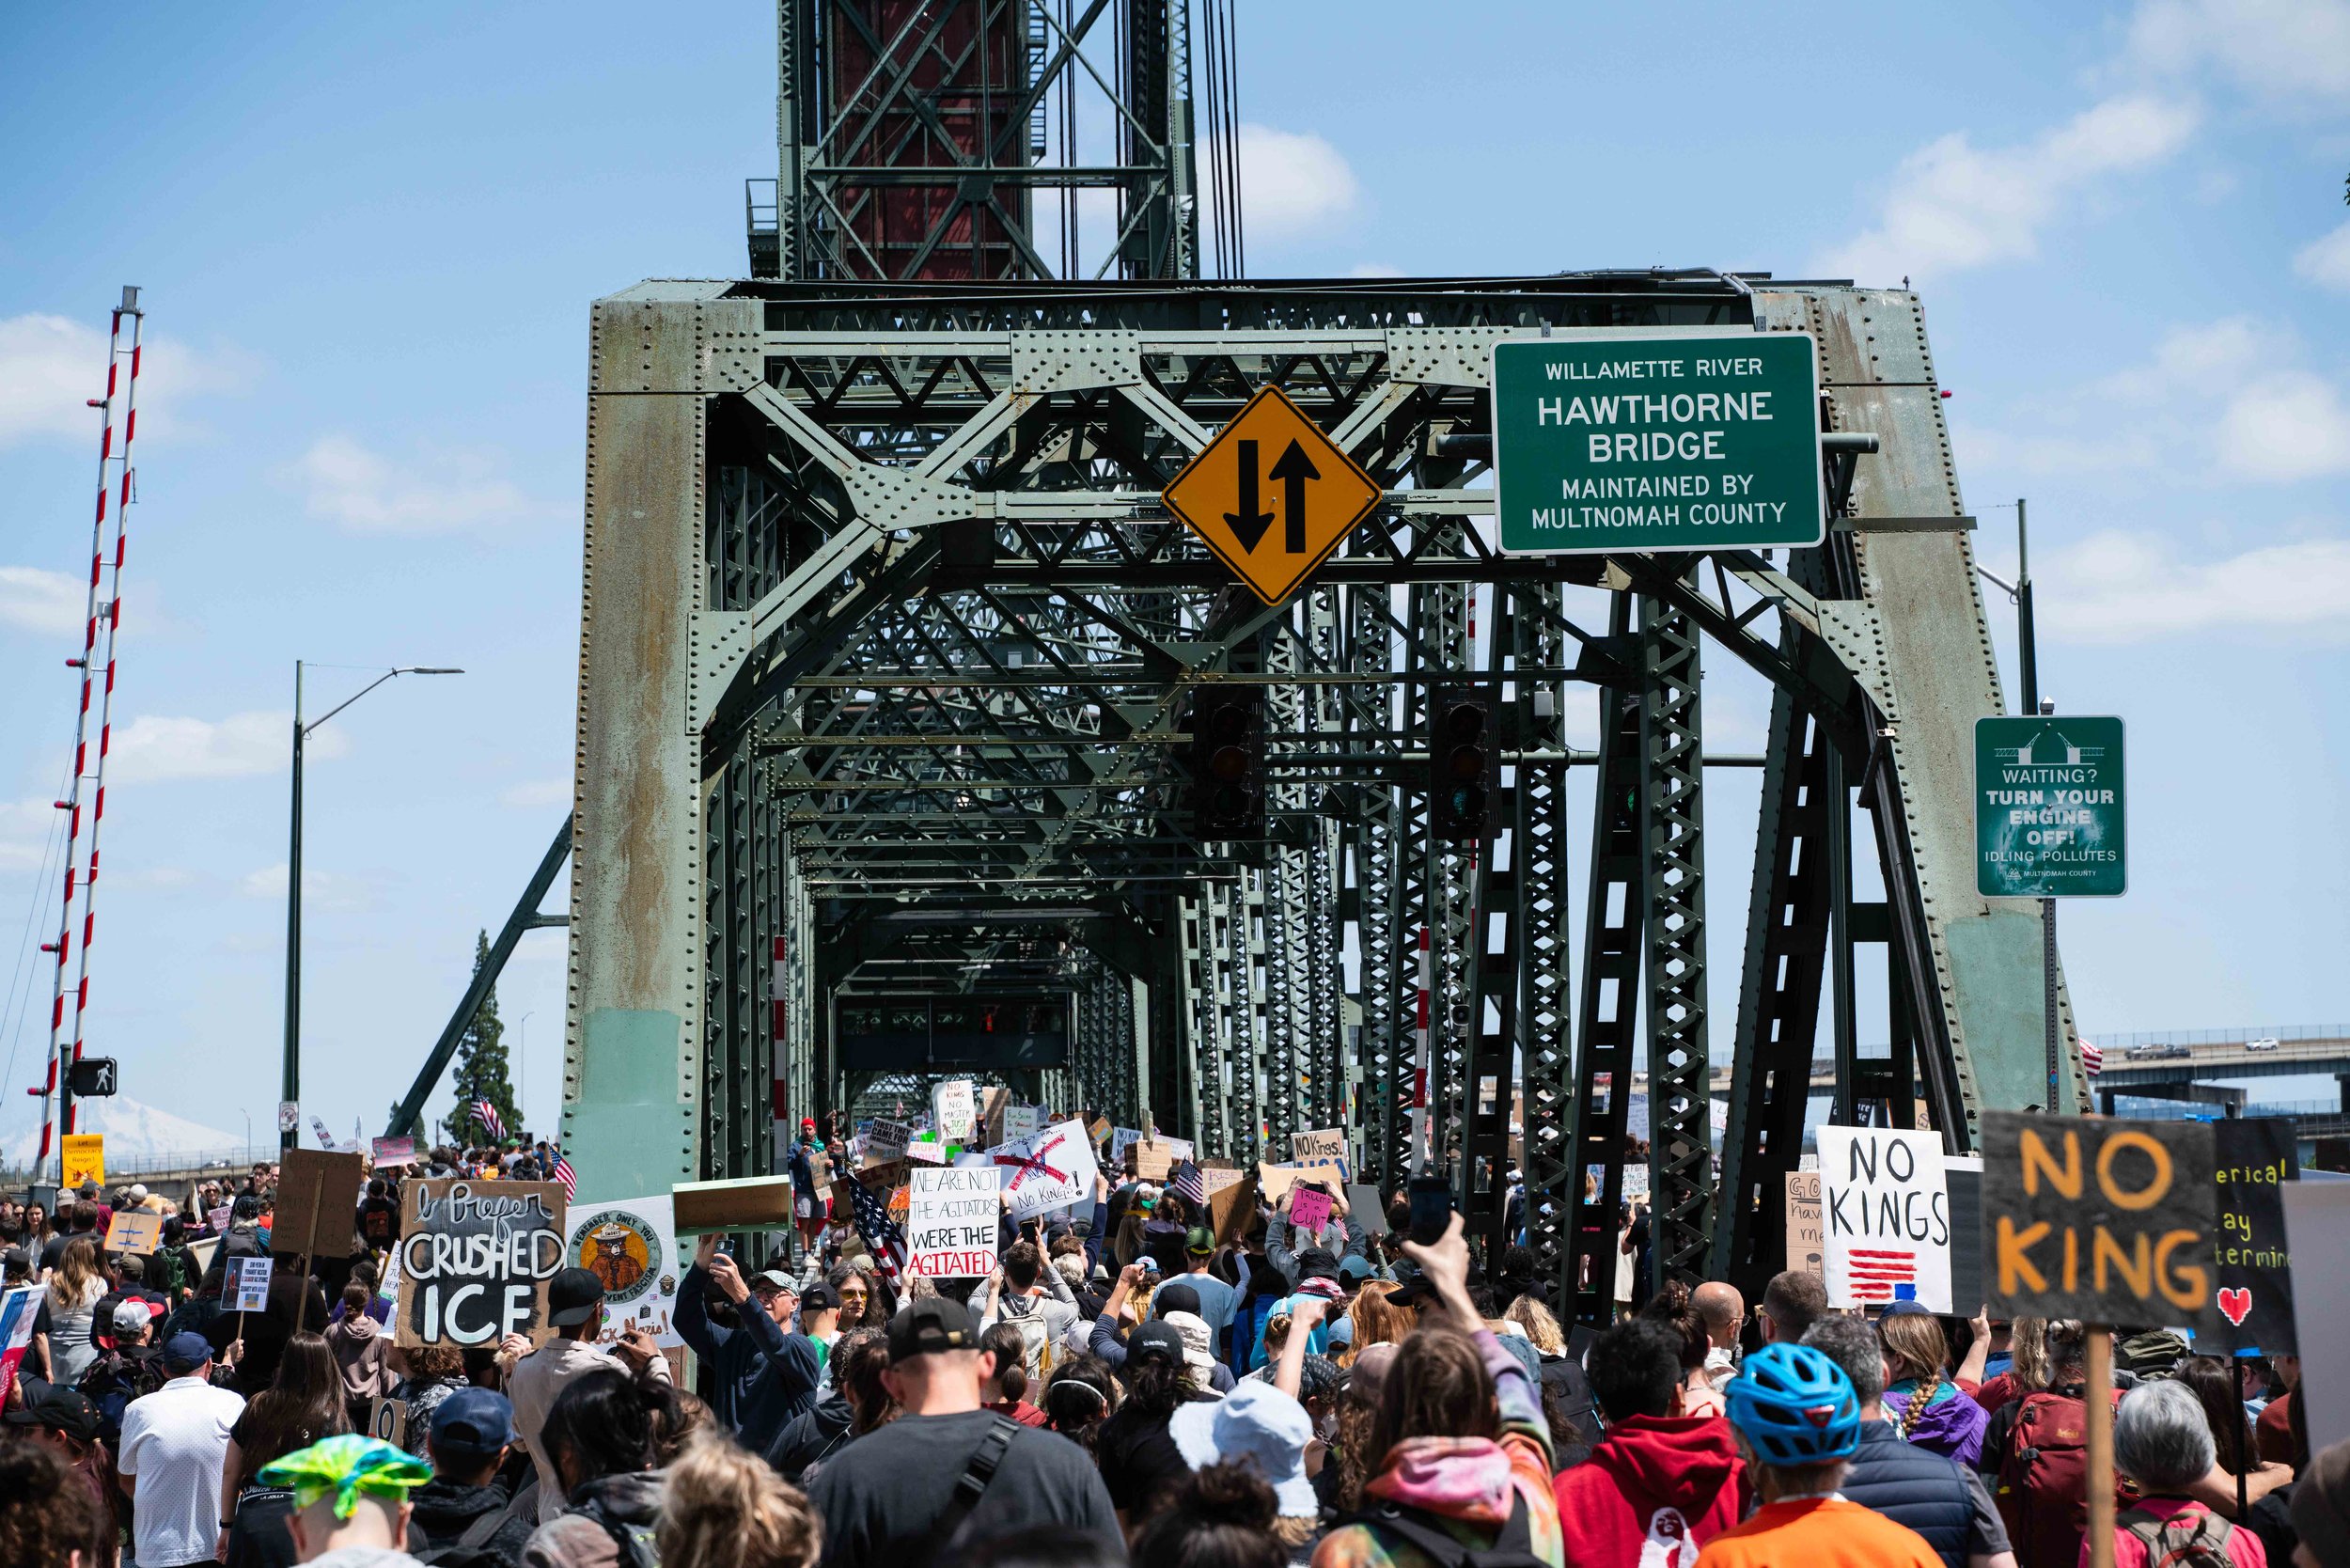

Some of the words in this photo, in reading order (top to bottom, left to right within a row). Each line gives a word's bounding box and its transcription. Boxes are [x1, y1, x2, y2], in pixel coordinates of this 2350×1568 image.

[1545, 360, 1684, 380] WILLAMETTE
[1697, 358, 1762, 376] RIVER
[1538, 392, 1773, 426] HAWTHORNE
[1589, 431, 1726, 463] BRIDGE
[1562, 476, 1710, 499] MAINTAINED
[1722, 475, 1754, 495] BY
[1532, 505, 1680, 529] MULTNOMAH
[1689, 502, 1786, 525] COUNTY
[2002, 769, 2098, 783] WAITING?
[1986, 790, 2044, 805] TURN
[2053, 790, 2114, 805] YOUR
[2010, 809, 2092, 825] ENGINE
[2027, 830, 2075, 846] OFF!
[1985, 851, 2034, 862] IDLING
[2043, 850, 2116, 862] POLLUTES
[948, 1101, 963, 1109] NO
[871, 1128, 893, 1140] CAME
[893, 1134, 909, 1144] FOR
[874, 1120, 894, 1132] FIRST
[894, 1124, 911, 1136] THEY
[1118, 1129, 1127, 1139] NO
[870, 1136, 903, 1149] IMMIGRANTS
[1294, 1136, 1311, 1157] NO
[1310, 1135, 1343, 1156] Kings!
[1850, 1136, 1914, 1184] NO
[2020, 1128, 2173, 1211] NO
[2216, 1157, 2285, 1185] erica!
[911, 1170, 933, 1193] WE
[937, 1170, 965, 1191] ARE
[968, 1169, 999, 1191] NOT
[449, 1183, 555, 1247] Prefer
[911, 1201, 933, 1219] THE
[939, 1199, 999, 1218] AGITATORS
[1829, 1186, 1948, 1246] KINGS
[572, 1213, 610, 1247] REMEMBER
[617, 1213, 637, 1227] ONLY
[640, 1225, 654, 1242] YOU
[959, 1225, 995, 1246] THE
[404, 1229, 566, 1281] CRUSHED
[907, 1249, 996, 1276] AGITATED
[1996, 1215, 2208, 1311] KING
[628, 1267, 657, 1297] FASCISM
